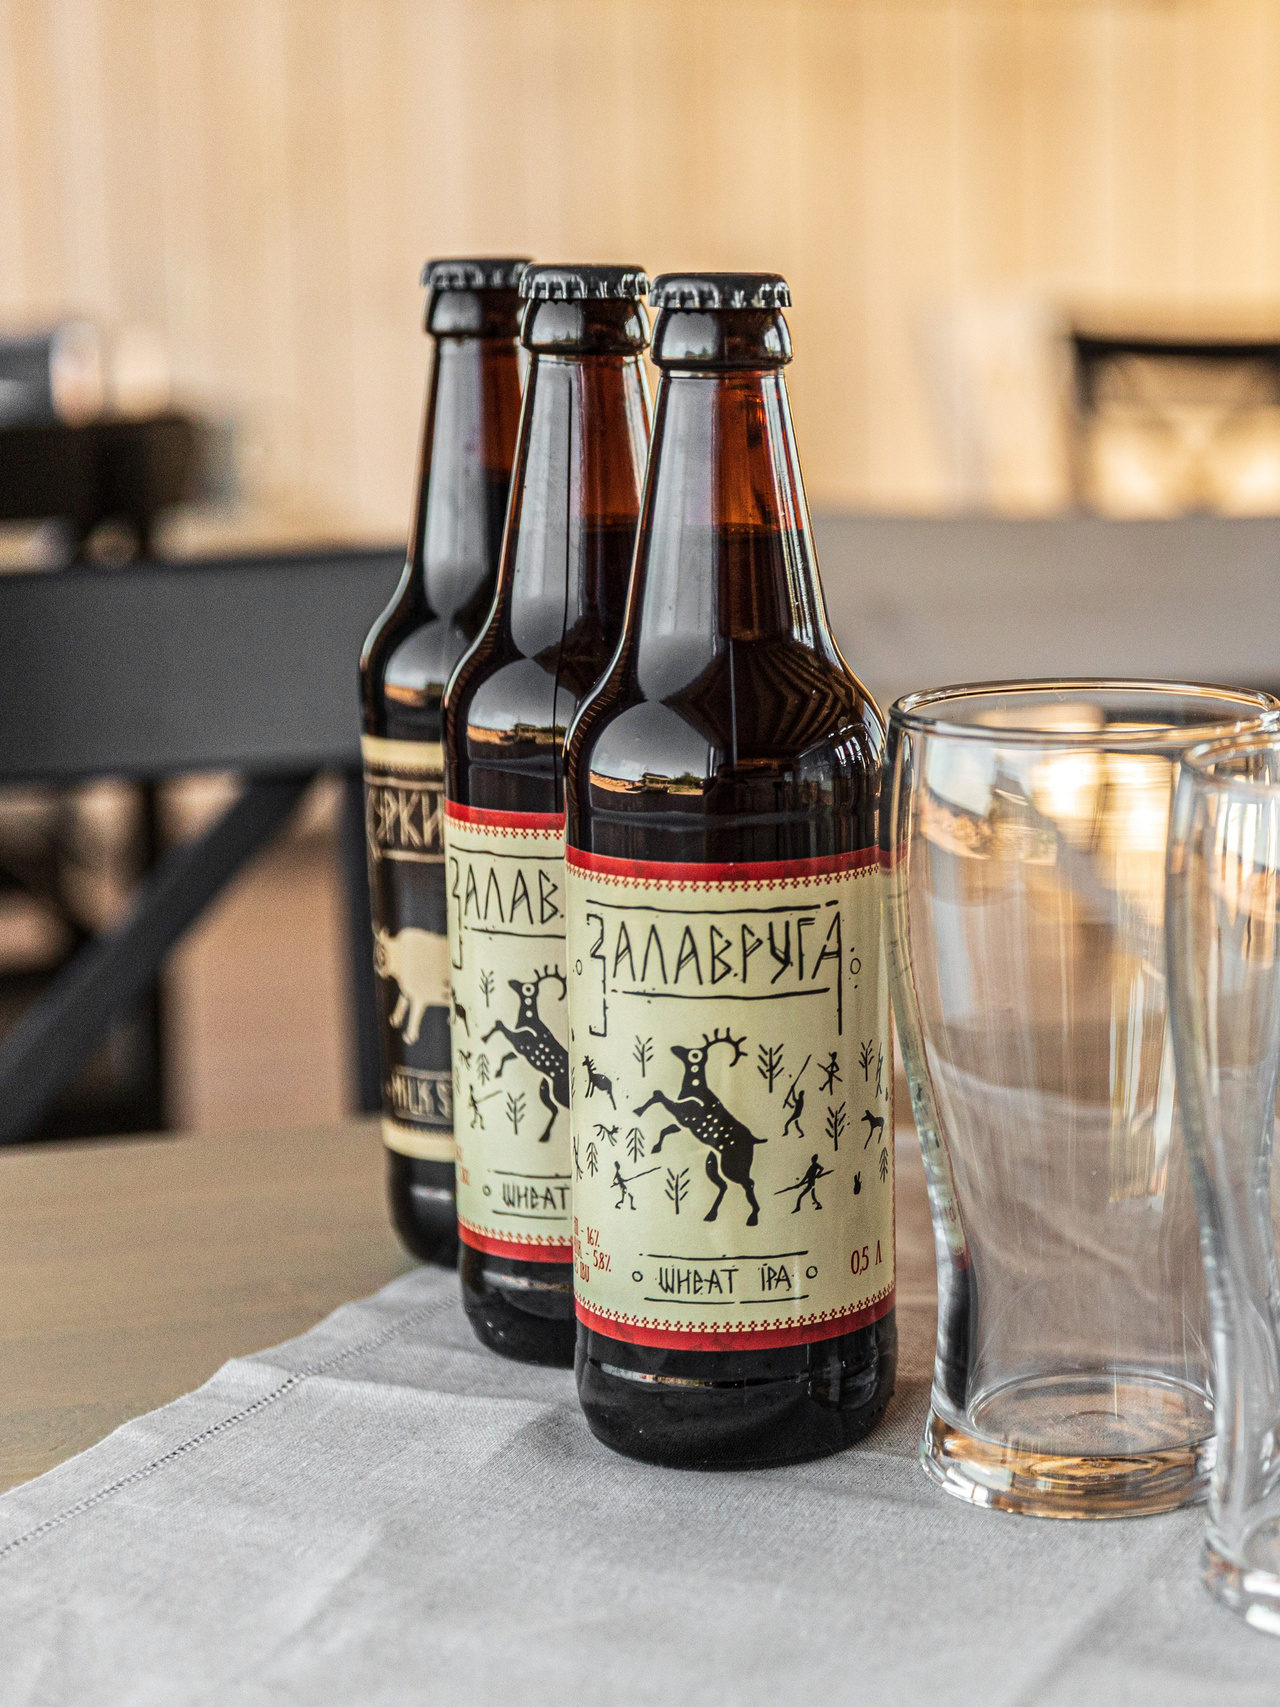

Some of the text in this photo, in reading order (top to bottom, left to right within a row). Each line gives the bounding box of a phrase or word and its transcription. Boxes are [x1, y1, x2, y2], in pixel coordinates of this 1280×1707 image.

[586, 911, 844, 1038] ЗАЛАВРУГА
[502, 1183, 570, 1210] WHEAT
[658, 1263, 792, 1295] WHEAT IPA
